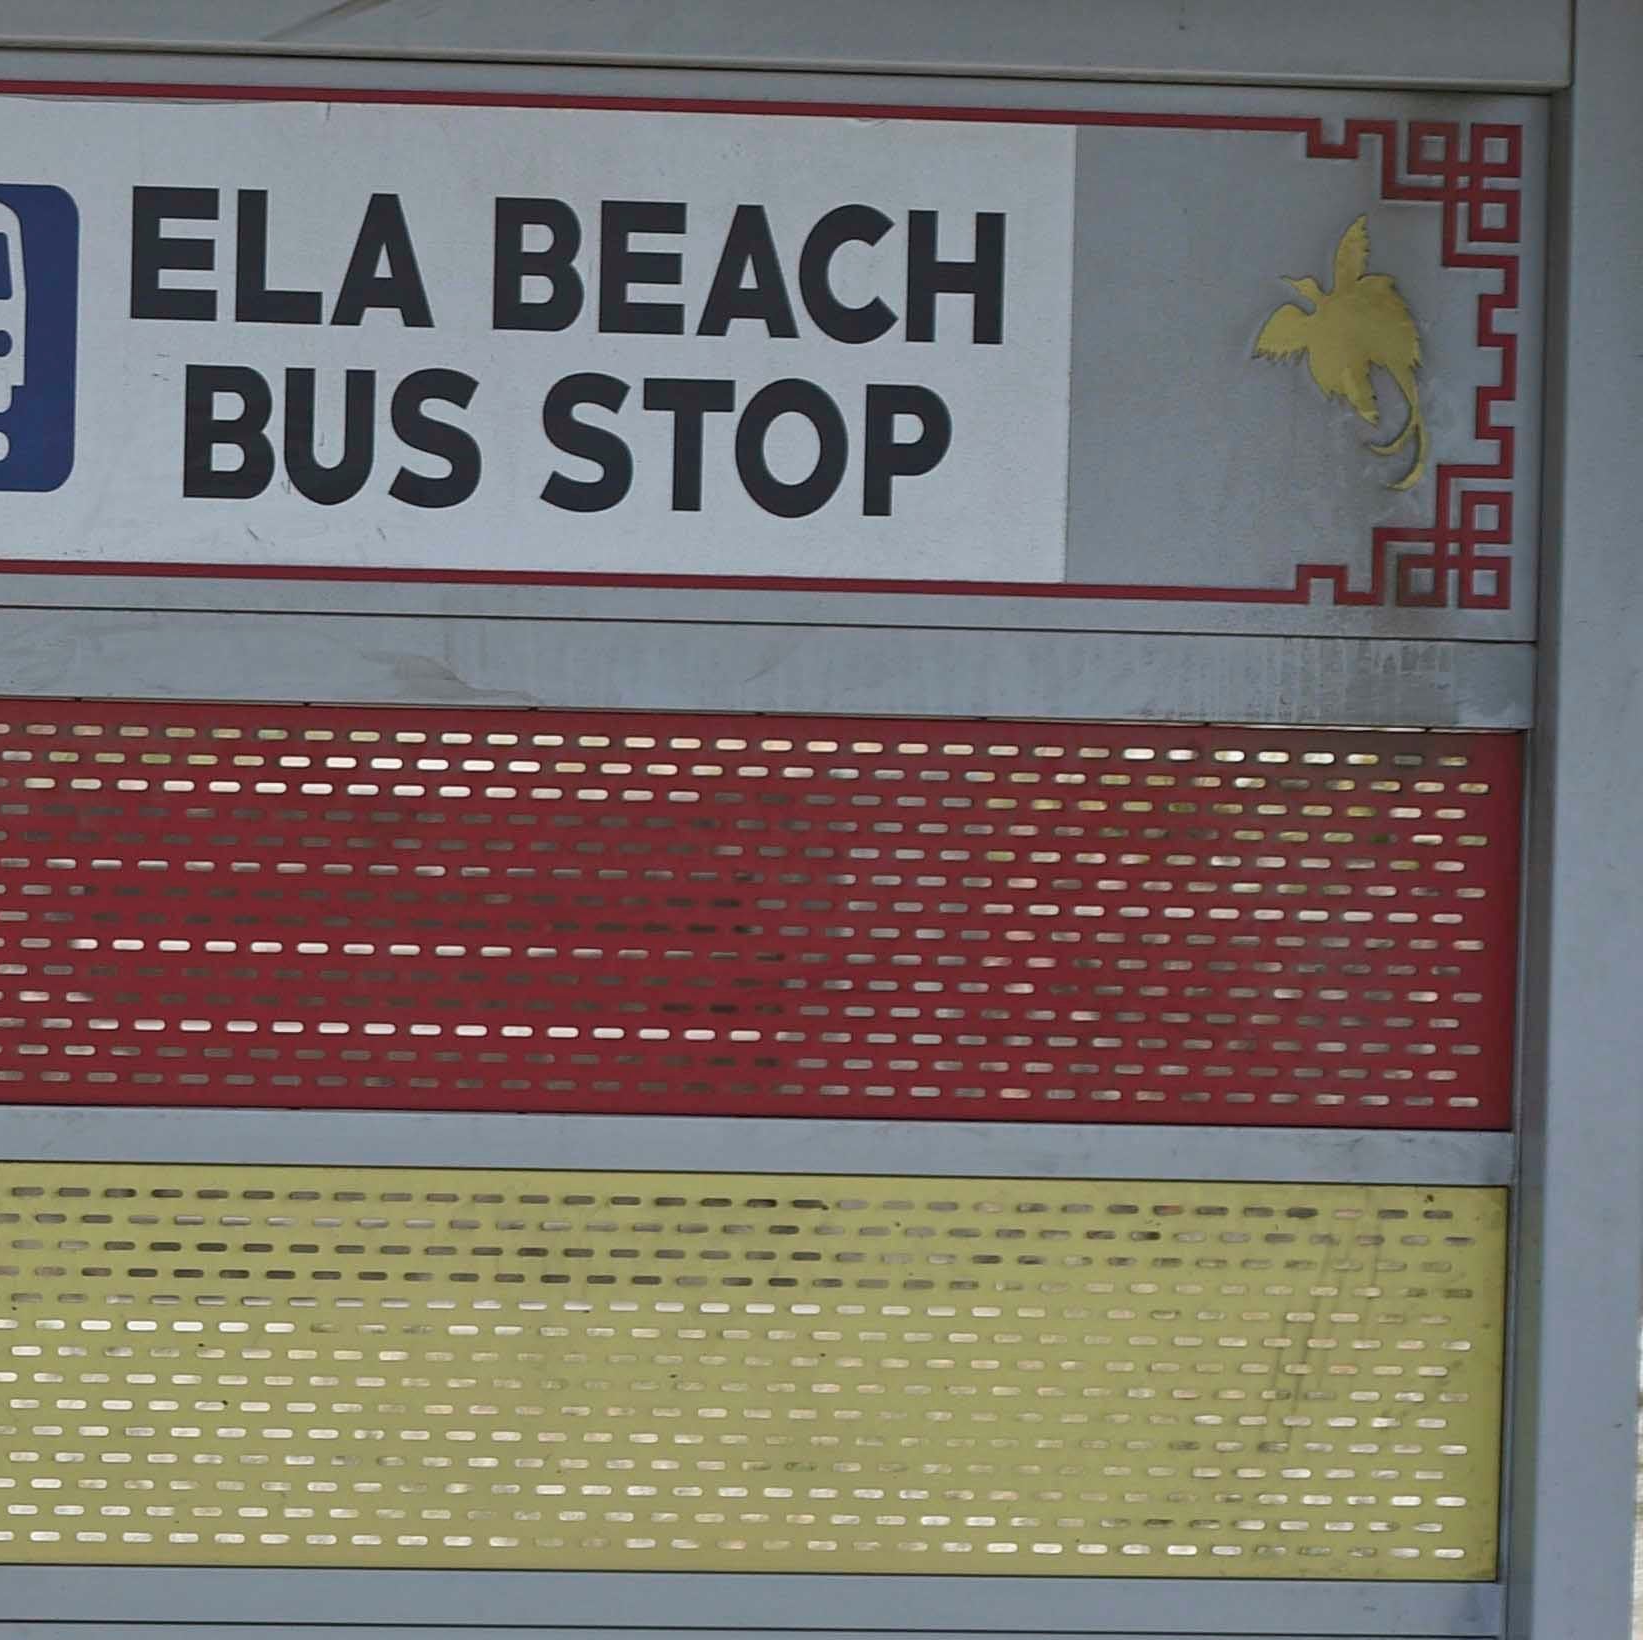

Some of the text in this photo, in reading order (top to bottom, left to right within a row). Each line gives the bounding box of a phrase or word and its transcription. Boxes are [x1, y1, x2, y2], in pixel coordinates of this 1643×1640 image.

[128, 185, 1007, 347] ELA BEACH
[182, 362, 953, 520] BUS STOP
